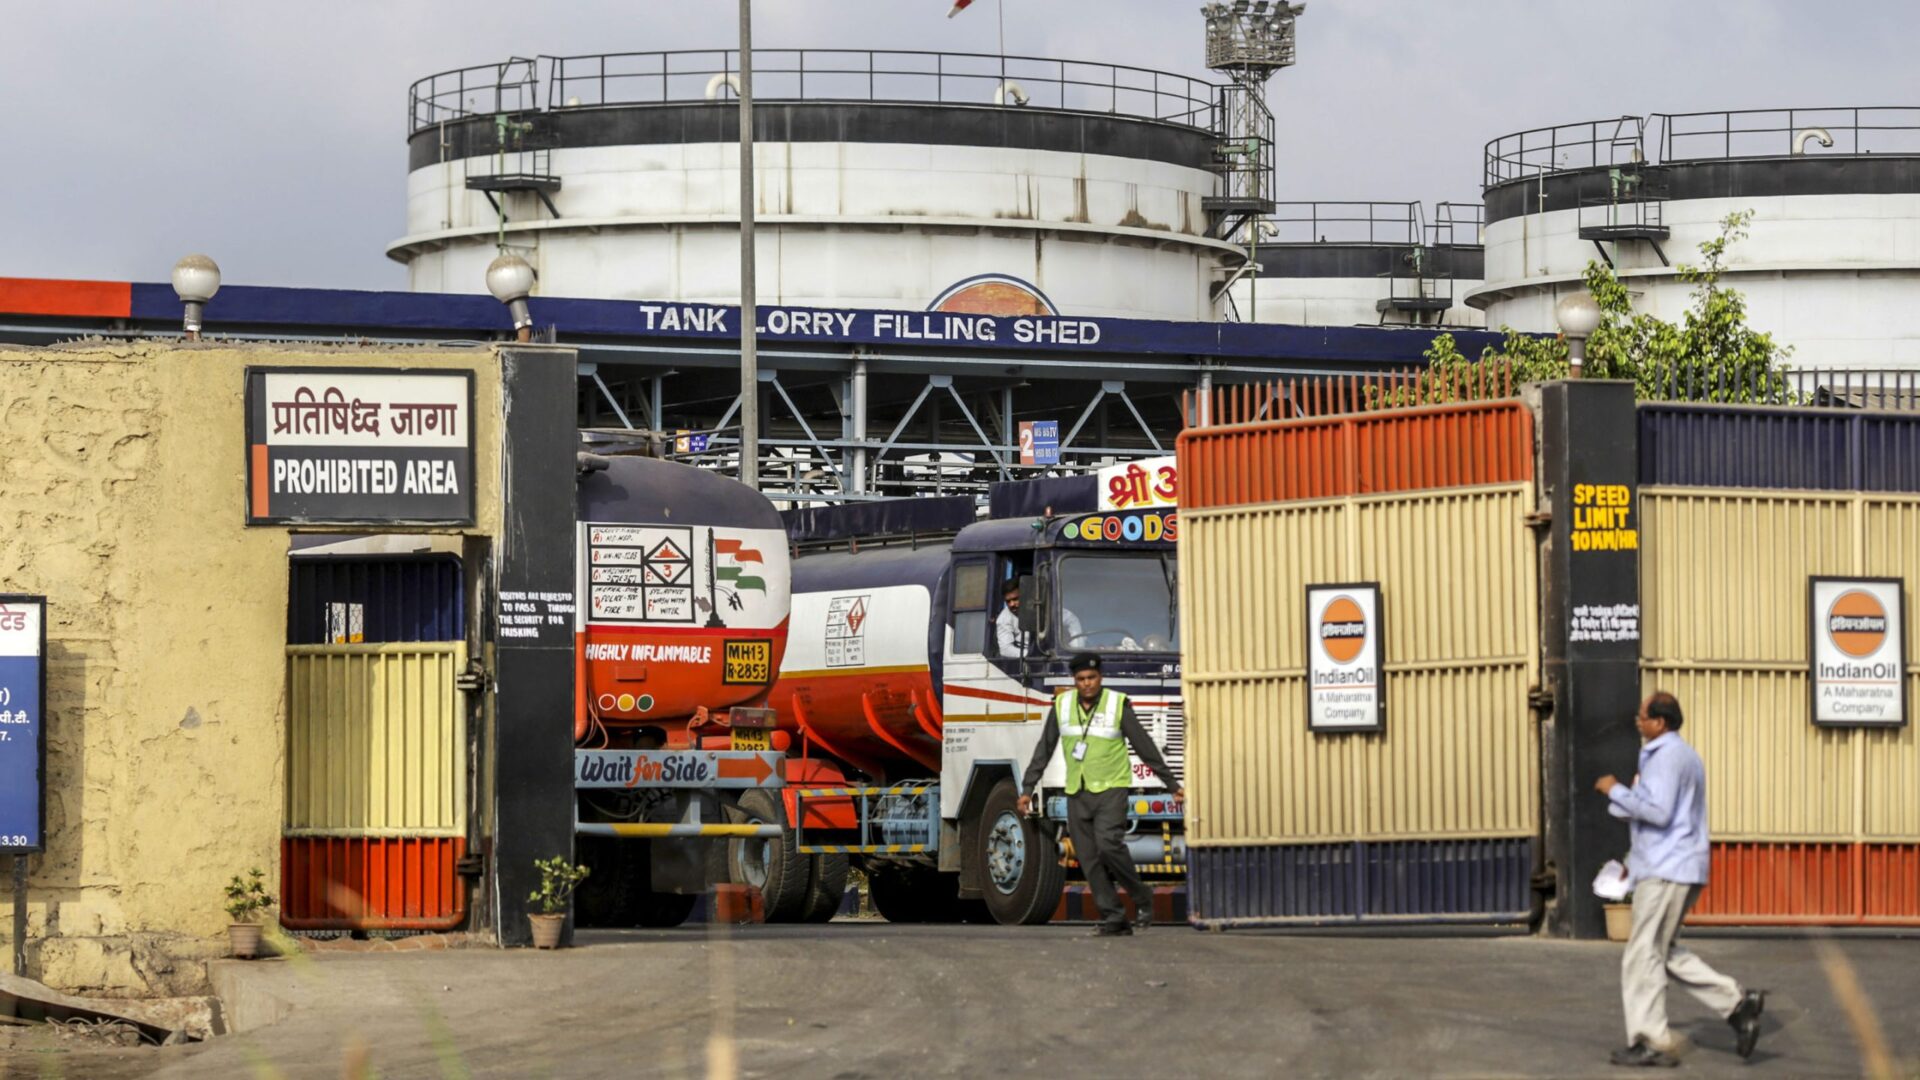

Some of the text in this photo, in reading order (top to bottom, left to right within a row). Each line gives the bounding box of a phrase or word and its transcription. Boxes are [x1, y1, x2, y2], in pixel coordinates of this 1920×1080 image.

[639, 305, 728, 333] TANK
[873, 312, 997, 341] FILLING
[1013, 318, 1101, 345] SHED
[389, 403, 458, 436] जागा
[1021, 428, 1034, 457] 2
[273, 458, 459, 495] PROHIBITED AREA
[1107, 463, 1152, 509] श्री
[1573, 483, 1630, 506] SPEED
[1573, 507, 1630, 529] LIMIT
[1080, 514, 1178, 542] GOODS
[663, 564, 672, 578] 3
[502, 602, 513, 613] TO
[514, 602, 537, 613] PASS
[498, 614, 513, 625] THE
[547, 615, 565, 625] FOR
[500, 627, 539, 638] FRISKING
[585, 643, 711, 664] HIGHLY INFLAMMABLE
[1314, 667, 1375, 685] IndianOil
[1819, 663, 1897, 679] IndianOil
[1318, 691, 1373, 703] A Maharatna
[1824, 686, 1894, 698] A Maharatna
[1324, 707, 1367, 720] Company
[1832, 701, 1886, 715] Company
[581, 755, 709, 788] Wait for Side
